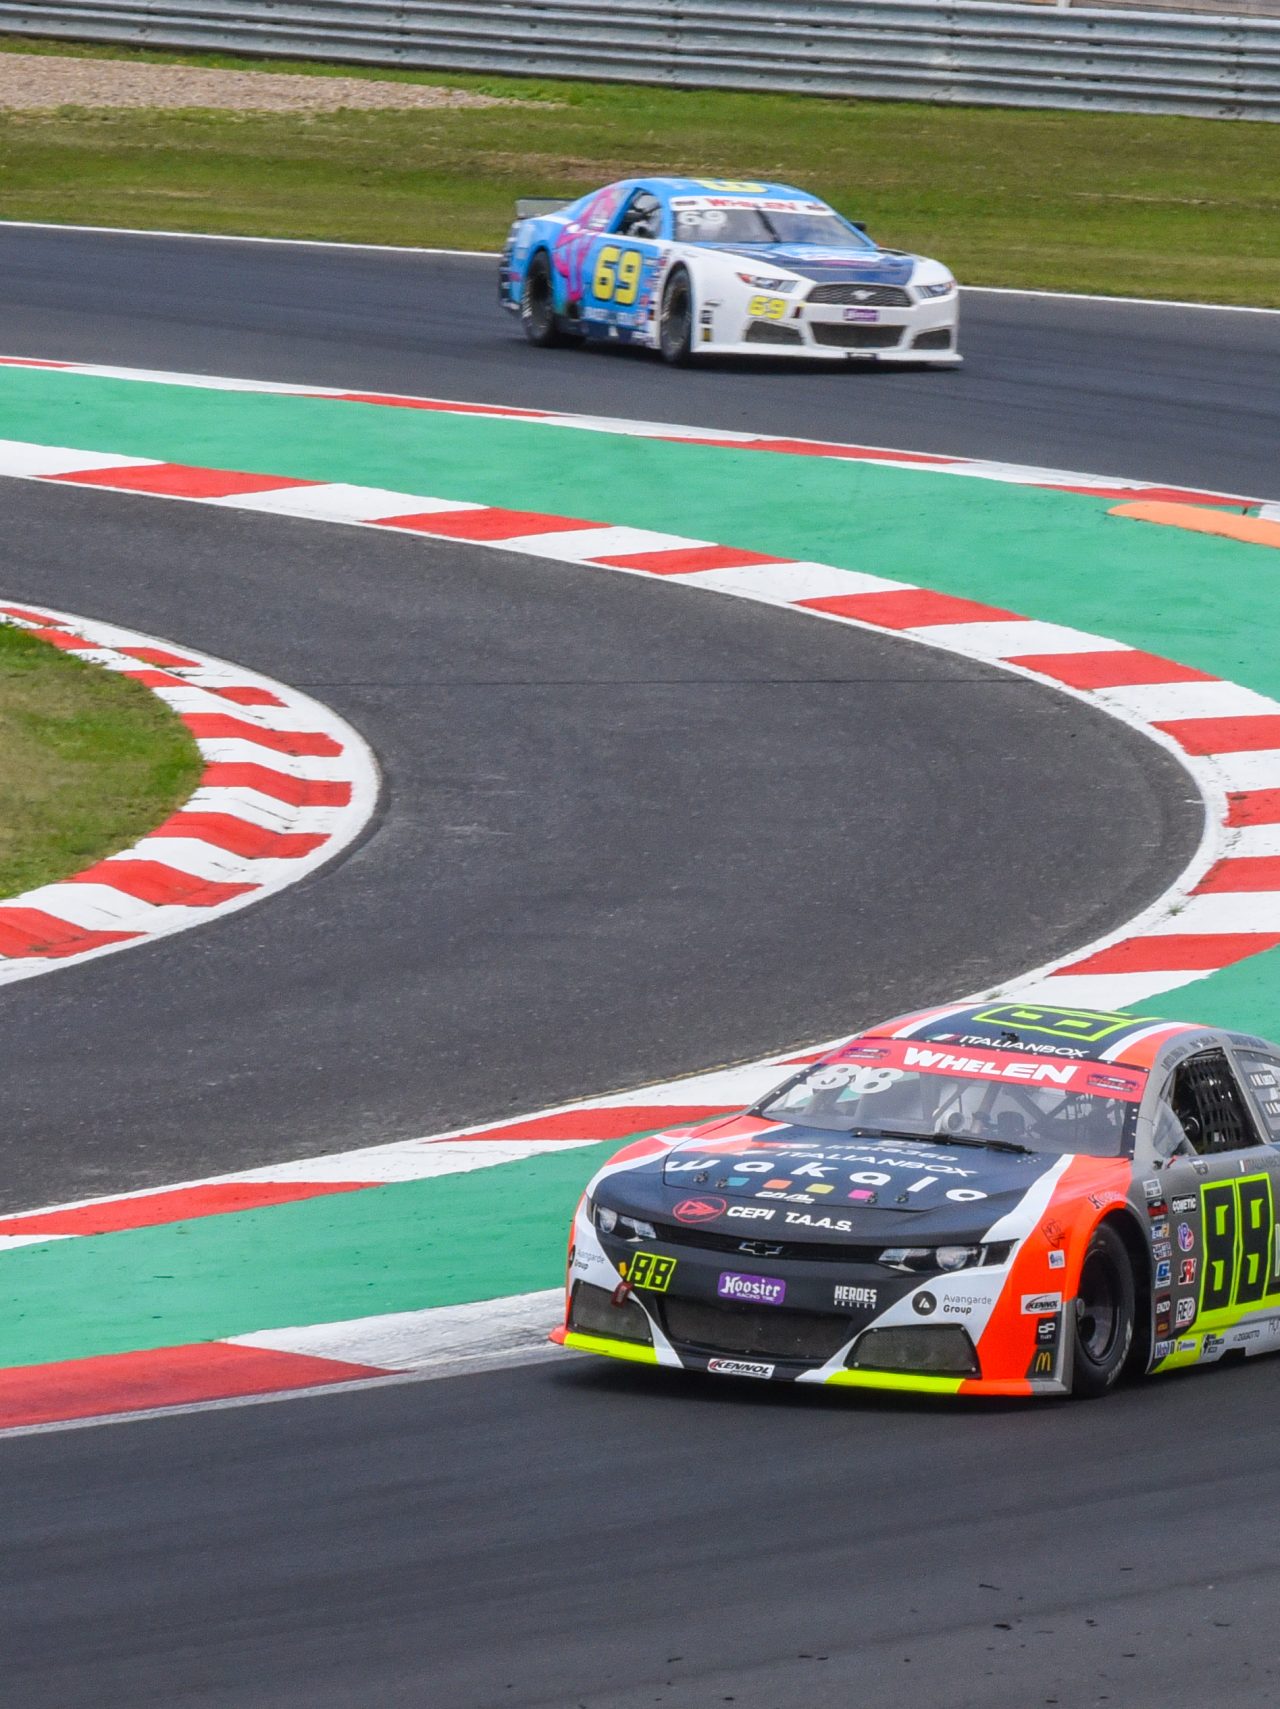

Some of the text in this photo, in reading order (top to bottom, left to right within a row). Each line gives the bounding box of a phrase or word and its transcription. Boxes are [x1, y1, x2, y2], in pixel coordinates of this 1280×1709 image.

[677, 210, 728, 227] 69
[592, 244, 643, 305] 69
[747, 294, 788, 320] 69
[961, 1034, 1090, 1059] ITALIANBOX
[901, 1047, 1080, 1084] WHELEN
[776, 1150, 980, 1178] ITALIANBOX
[664, 1157, 988, 1203] wakalo
[726, 1205, 853, 1233] CEPI T.A.A.S.
[1200, 1172, 1275, 1312] 88
[626, 1250, 677, 1292] 88
[720, 1275, 781, 1298] Hoosier
[833, 1284, 878, 1303] HEROES
[943, 1294, 993, 1306] Avangarde
[943, 1304, 973, 1315] Group
[714, 1360, 773, 1375] KENNOL
